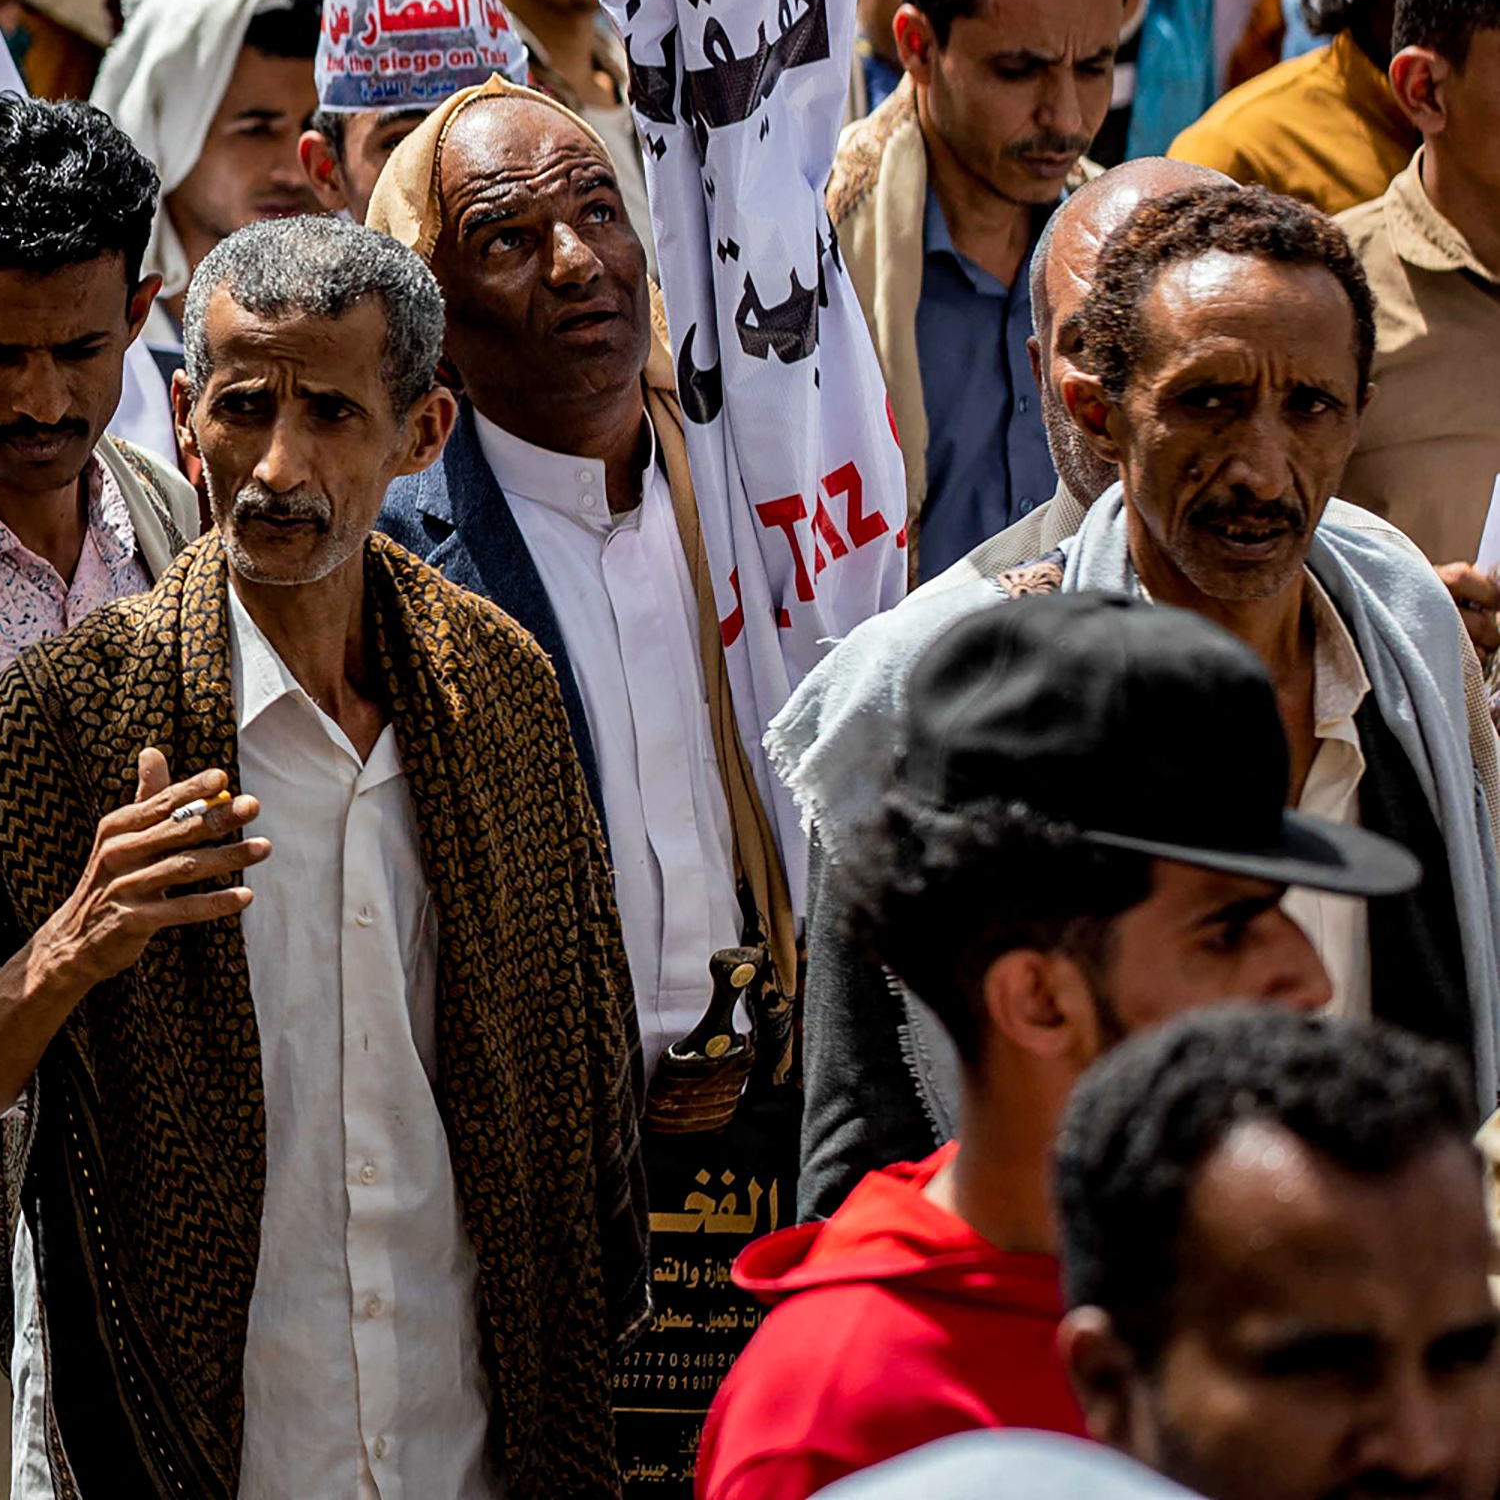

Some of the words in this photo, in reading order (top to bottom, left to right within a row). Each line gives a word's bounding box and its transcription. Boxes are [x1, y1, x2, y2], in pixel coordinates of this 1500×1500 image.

[350, 52, 373, 72] the
[378, 50, 442, 74] siege
[449, 51, 475, 67] on
[649, 1168, 779, 1235] الفخ
